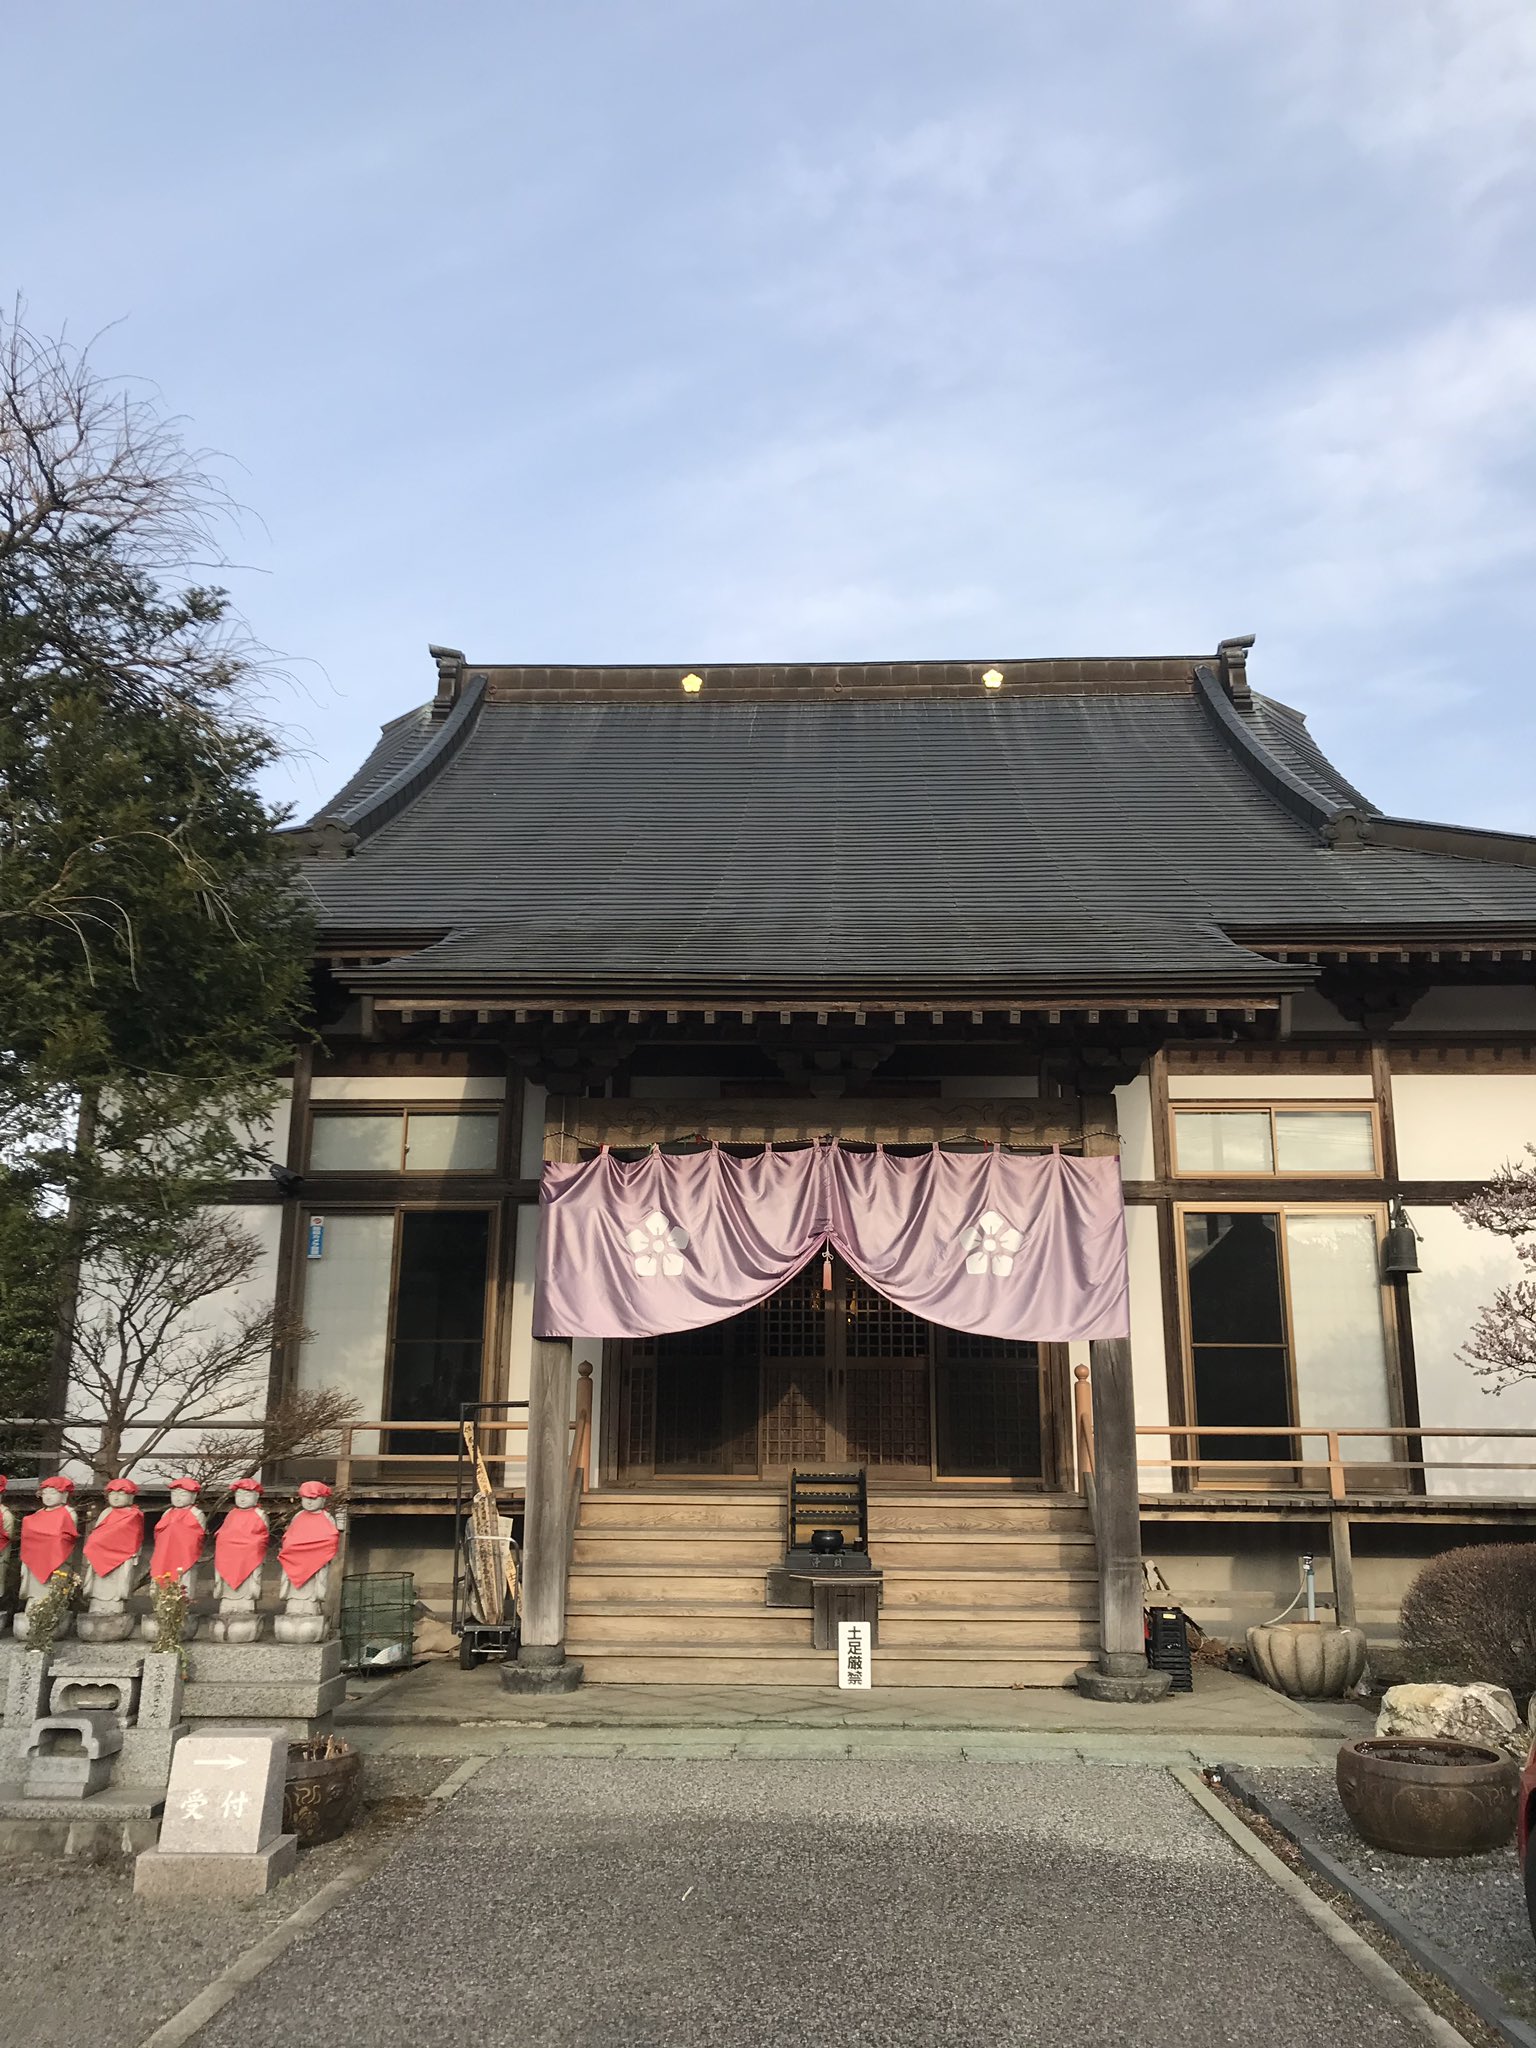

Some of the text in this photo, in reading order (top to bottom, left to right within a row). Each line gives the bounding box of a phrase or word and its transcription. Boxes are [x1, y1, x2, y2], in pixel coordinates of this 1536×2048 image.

[847, 1626, 863, 1685] 土足厳禁
[180, 1789, 249, 1820] 受付
